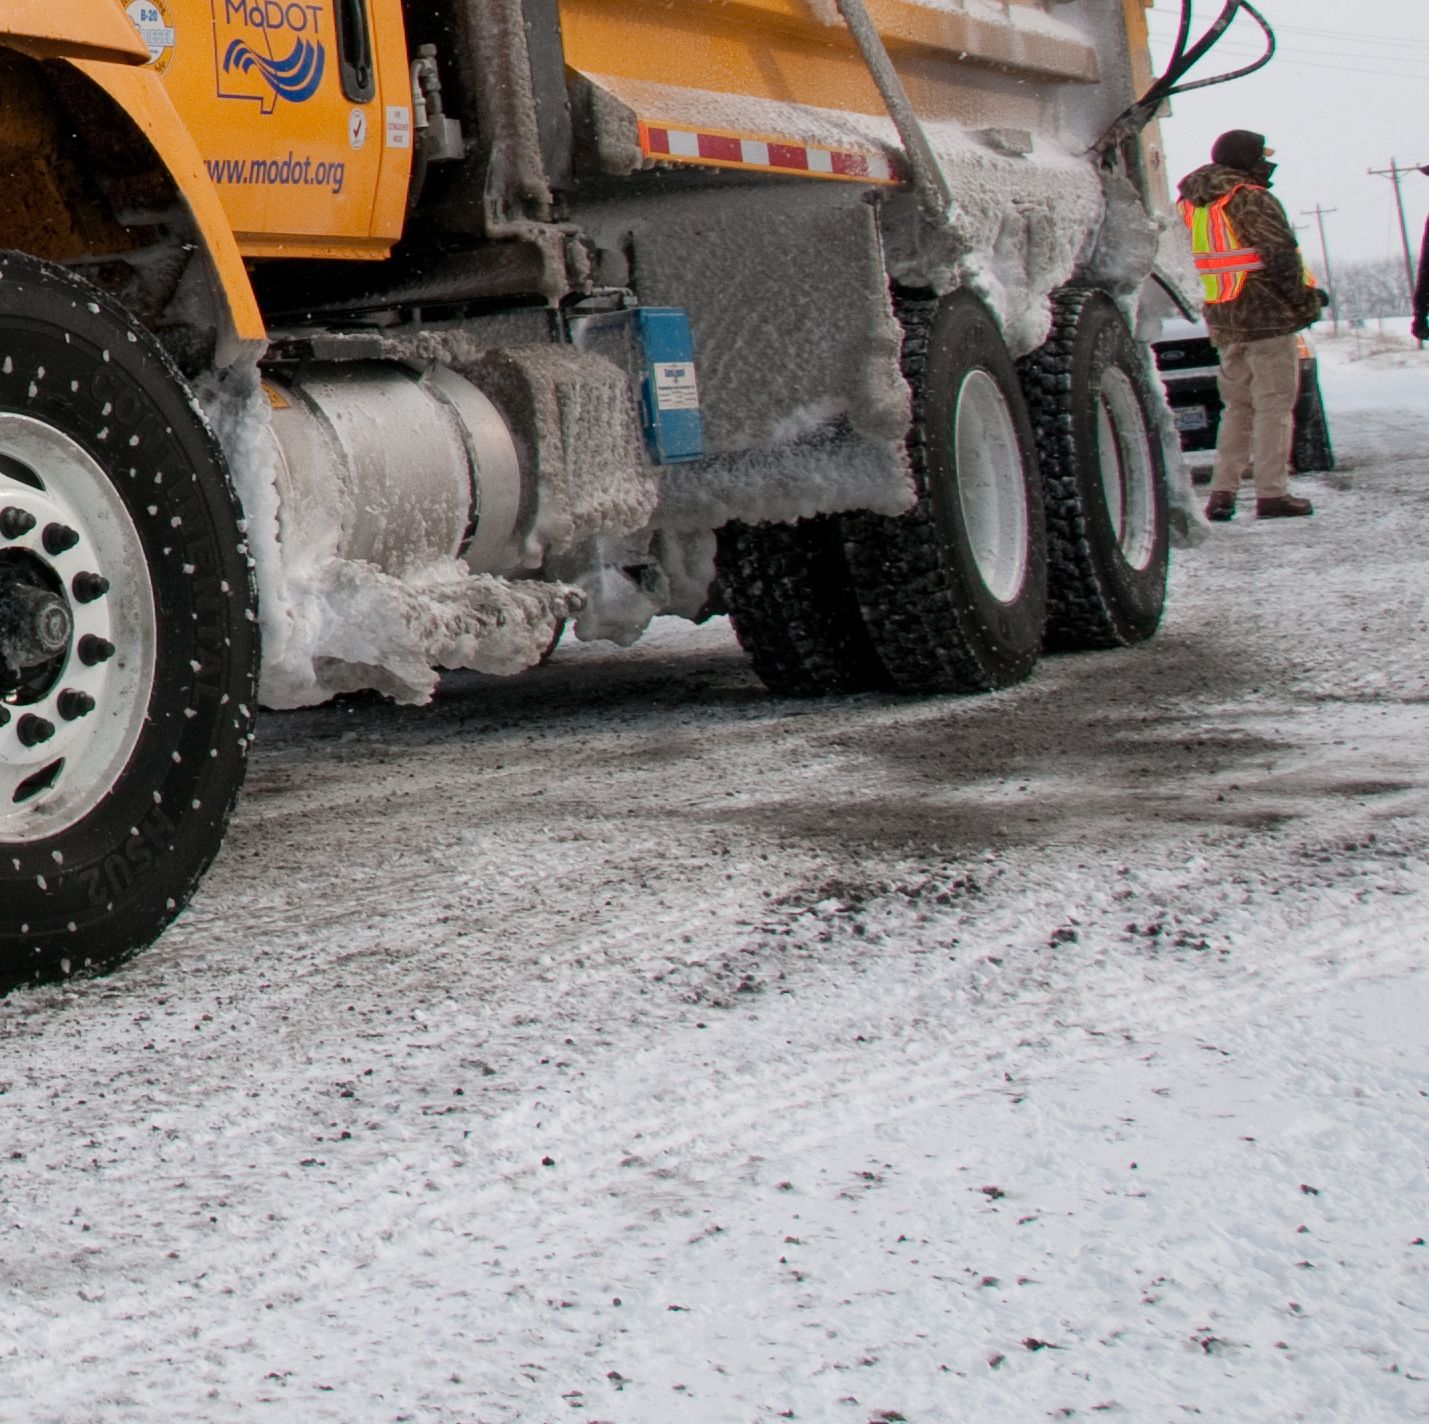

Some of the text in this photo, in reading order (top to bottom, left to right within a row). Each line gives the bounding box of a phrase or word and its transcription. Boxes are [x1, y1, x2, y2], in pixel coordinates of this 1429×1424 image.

[140, 8, 158, 22] B-20
[203, 150, 346, 195] ww.modot.org
[90, 363, 224, 710] CONTINENTAL
